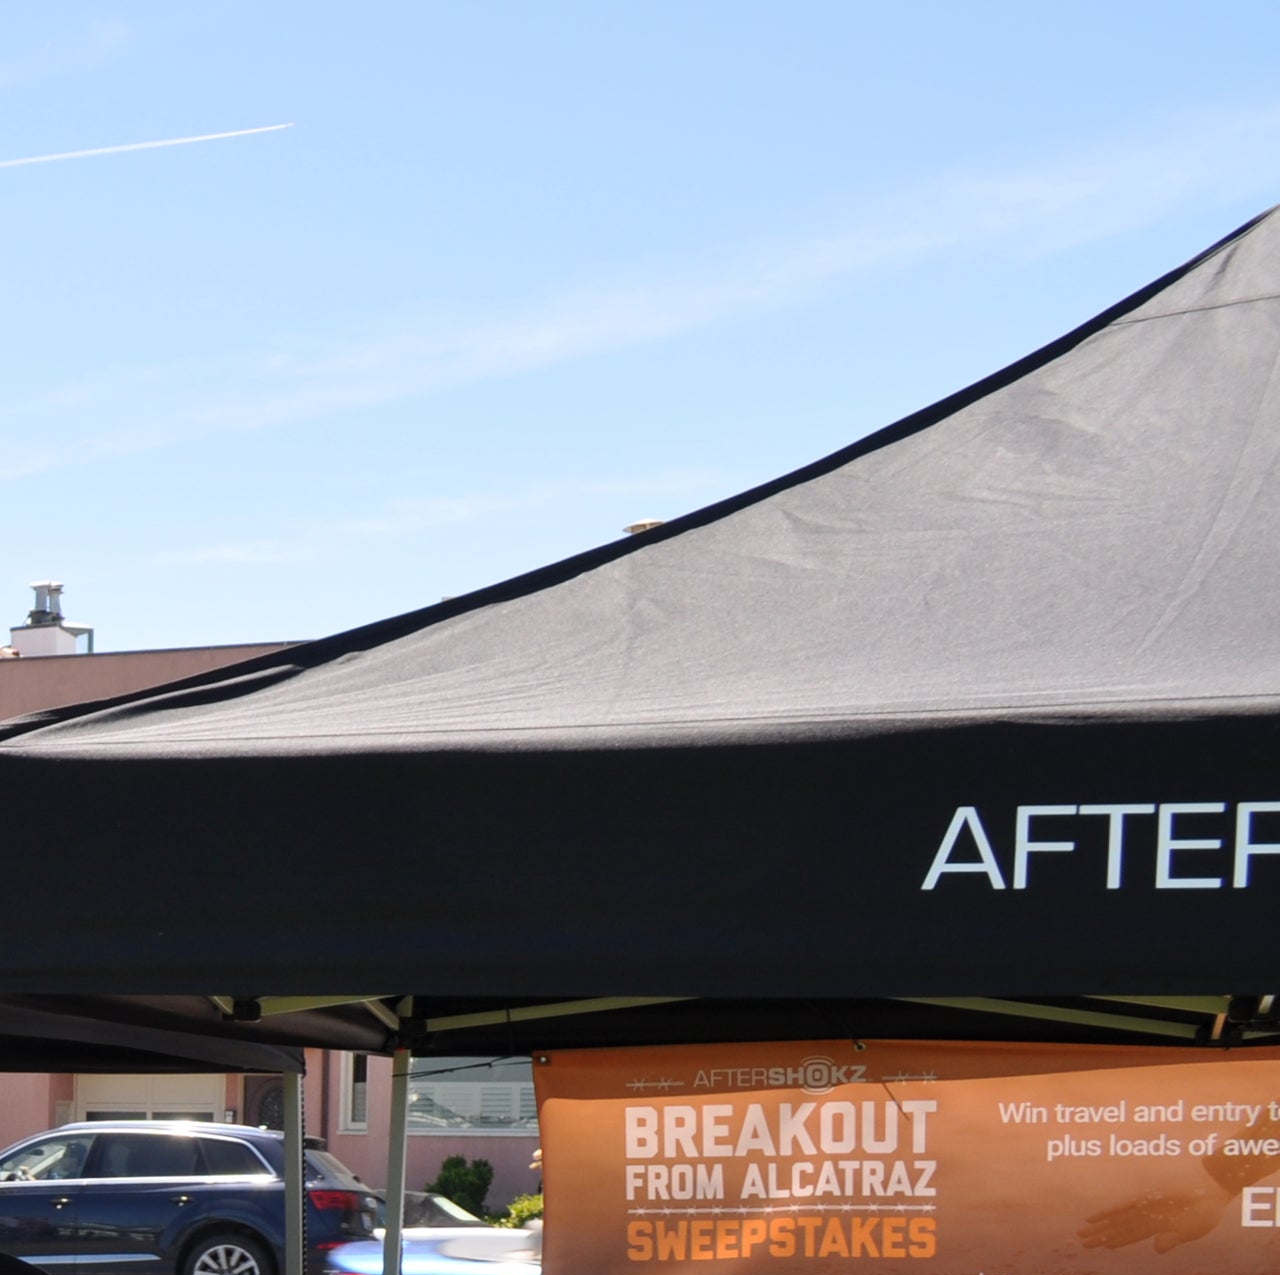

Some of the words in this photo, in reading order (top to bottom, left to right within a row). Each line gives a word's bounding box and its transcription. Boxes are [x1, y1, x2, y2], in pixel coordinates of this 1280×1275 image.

[693, 1062, 867, 1090] AFTERSHOKZ
[625, 1101, 937, 1159] BREAKOUT
[998, 1102, 1048, 1124] Win
[1054, 1100, 1126, 1123] travel
[1134, 1100, 1184, 1123] and
[1191, 1101, 1261, 1127] entry
[1267, 1102, 1280, 1122] t
[1047, 1134, 1102, 1162] plus
[1110, 1133, 1181, 1156] loads
[1188, 1133, 1218, 1156] of
[625, 1163, 724, 1200] FROM
[740, 1160, 937, 1199] ALCATRAZ
[1241, 1186, 1280, 1228] E
[627, 1217, 937, 1261] SWEEPSTAKES
